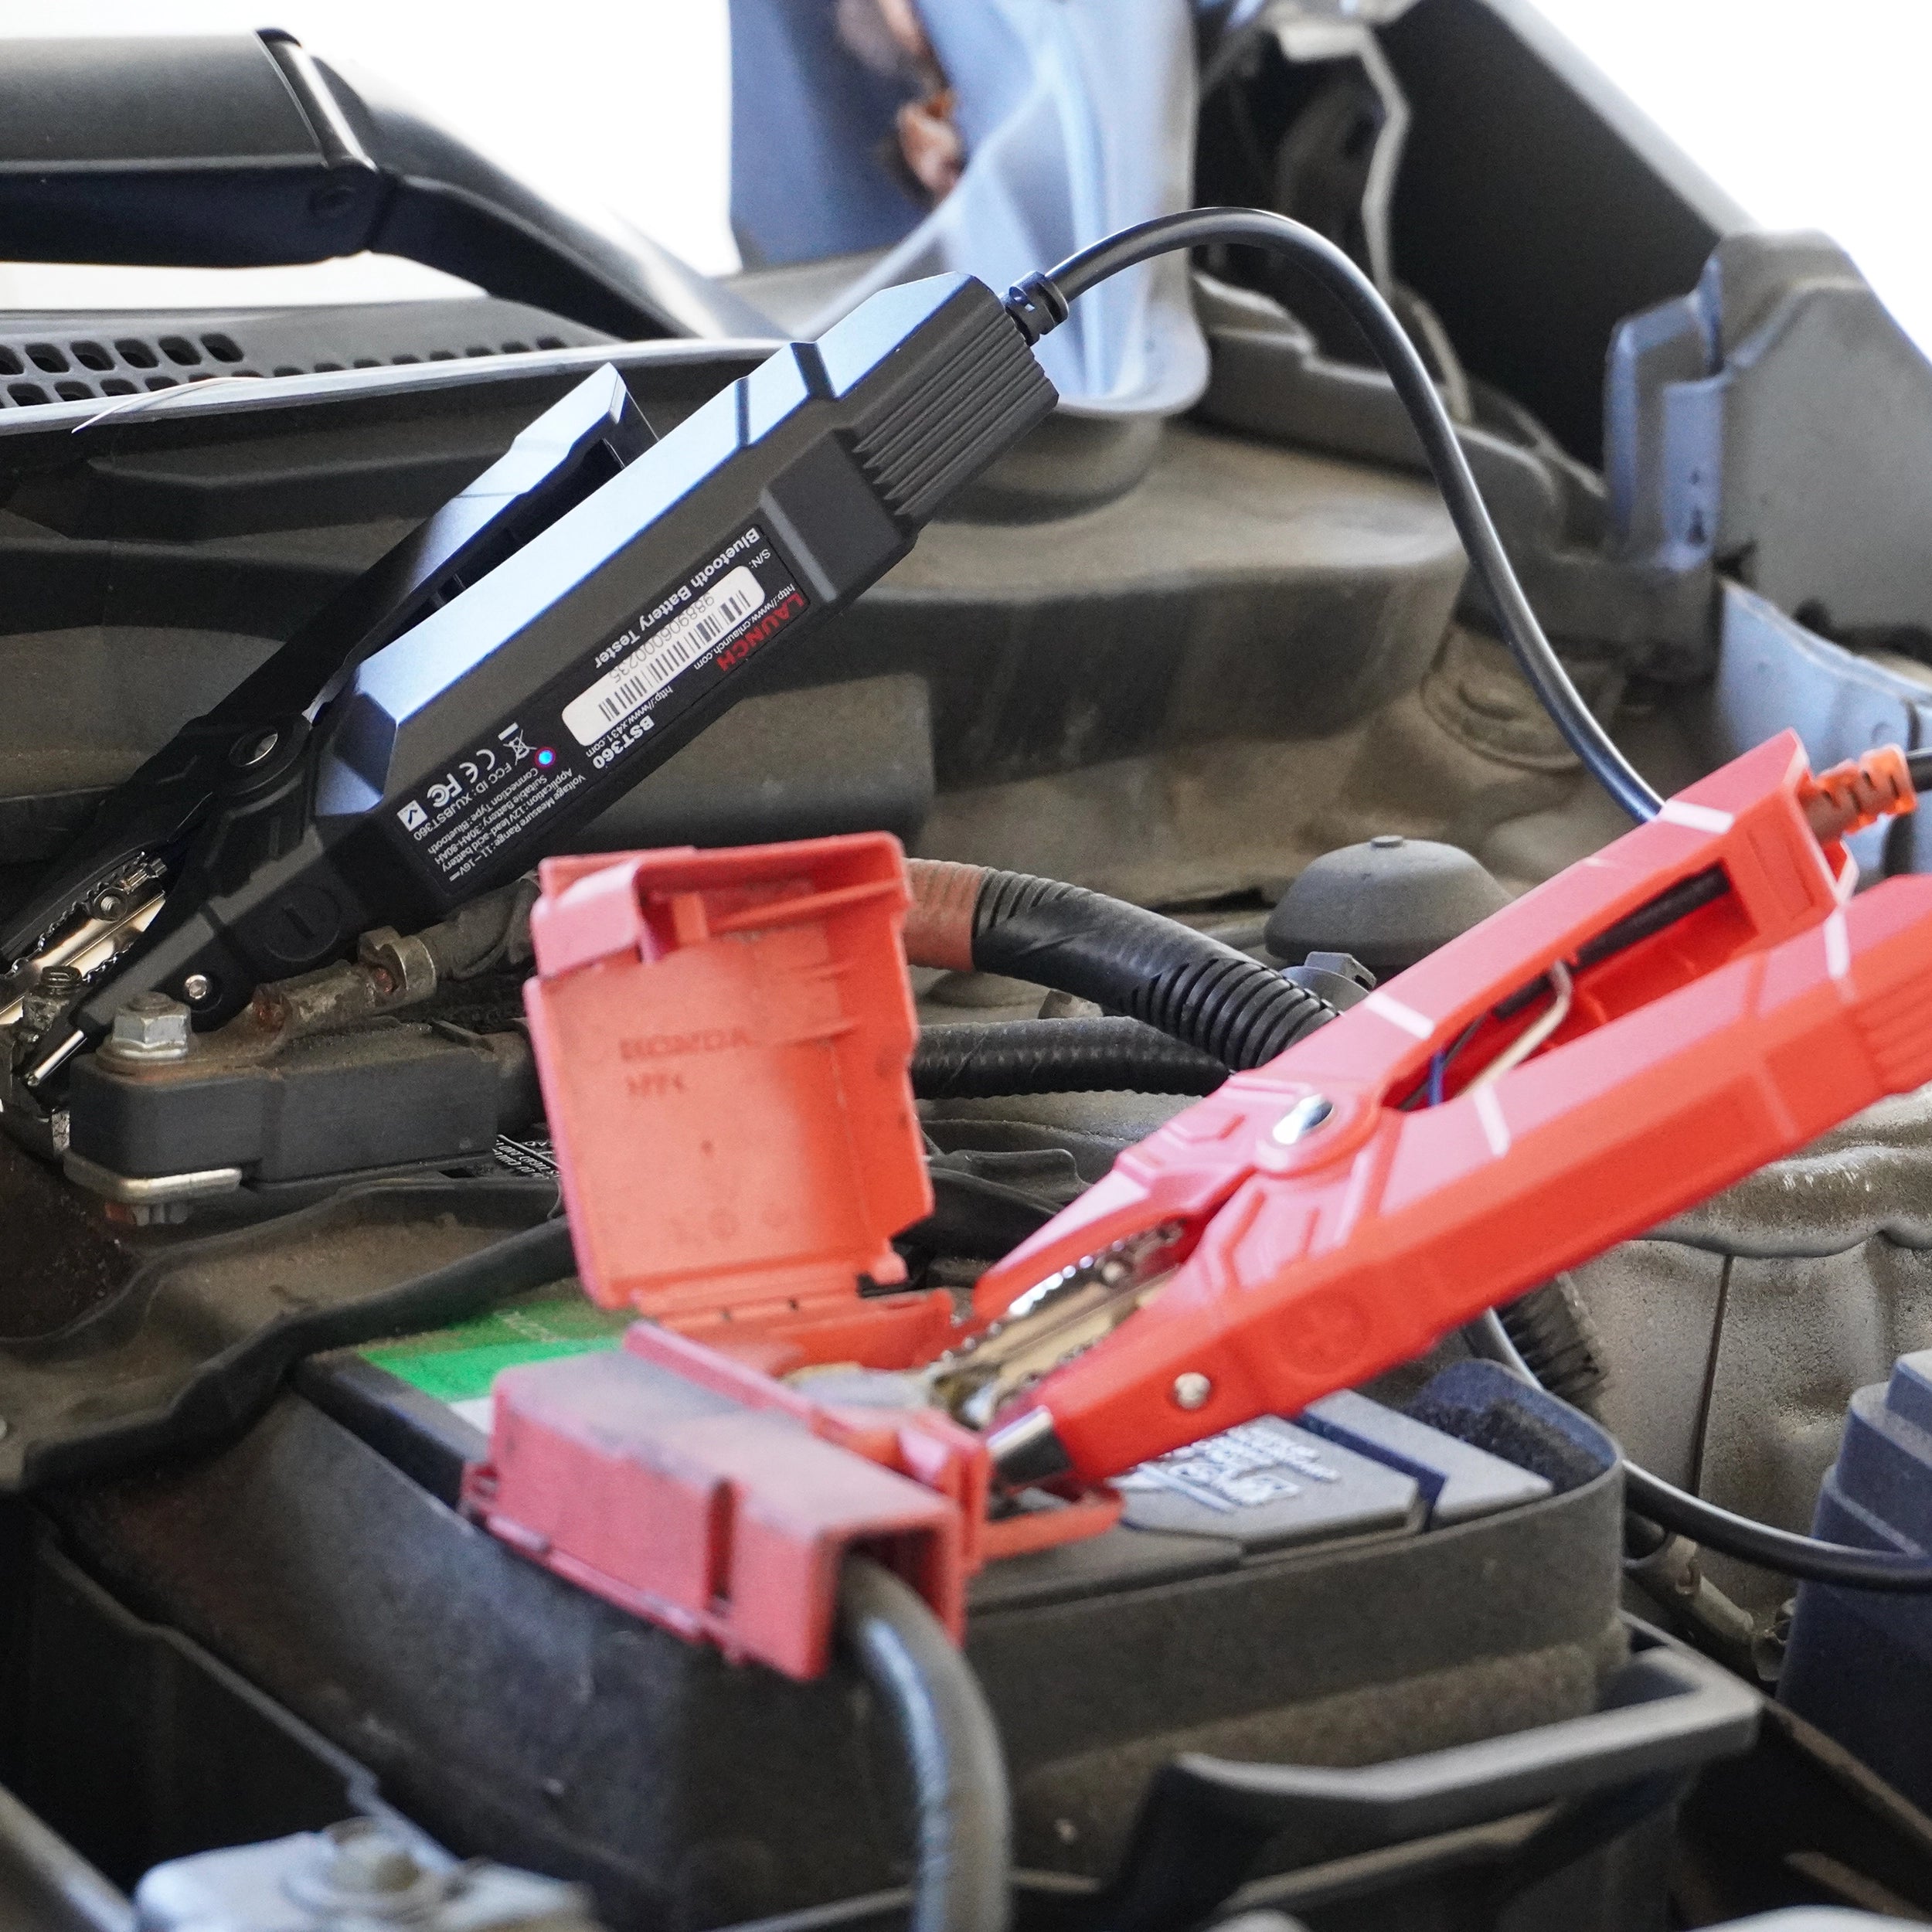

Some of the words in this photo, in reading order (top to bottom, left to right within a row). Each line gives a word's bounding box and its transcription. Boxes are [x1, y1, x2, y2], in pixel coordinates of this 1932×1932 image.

[690, 527, 760, 587] Bluetooth
[748, 549, 770, 569] S/N:
[639, 585, 692, 631] Battery
[693, 583, 796, 670] http://www.cnlaunch.com
[594, 630, 641, 668] Tester
[607, 590, 716, 685] 988906000235
[716, 593, 804, 670] LAUNCH
[586, 682, 673, 757] http://www.x431.com
[593, 715, 655, 769] BST360
[471, 780, 489, 796] ID:
[488, 762, 512, 784] FCC
[490, 767, 539, 806] Connection
[512, 774, 547, 803] Suitable
[553, 774, 586, 800] Voltage
[413, 792, 473, 841] XUJBST360
[519, 797, 556, 826] Measure
[442, 846, 474, 872] battery
